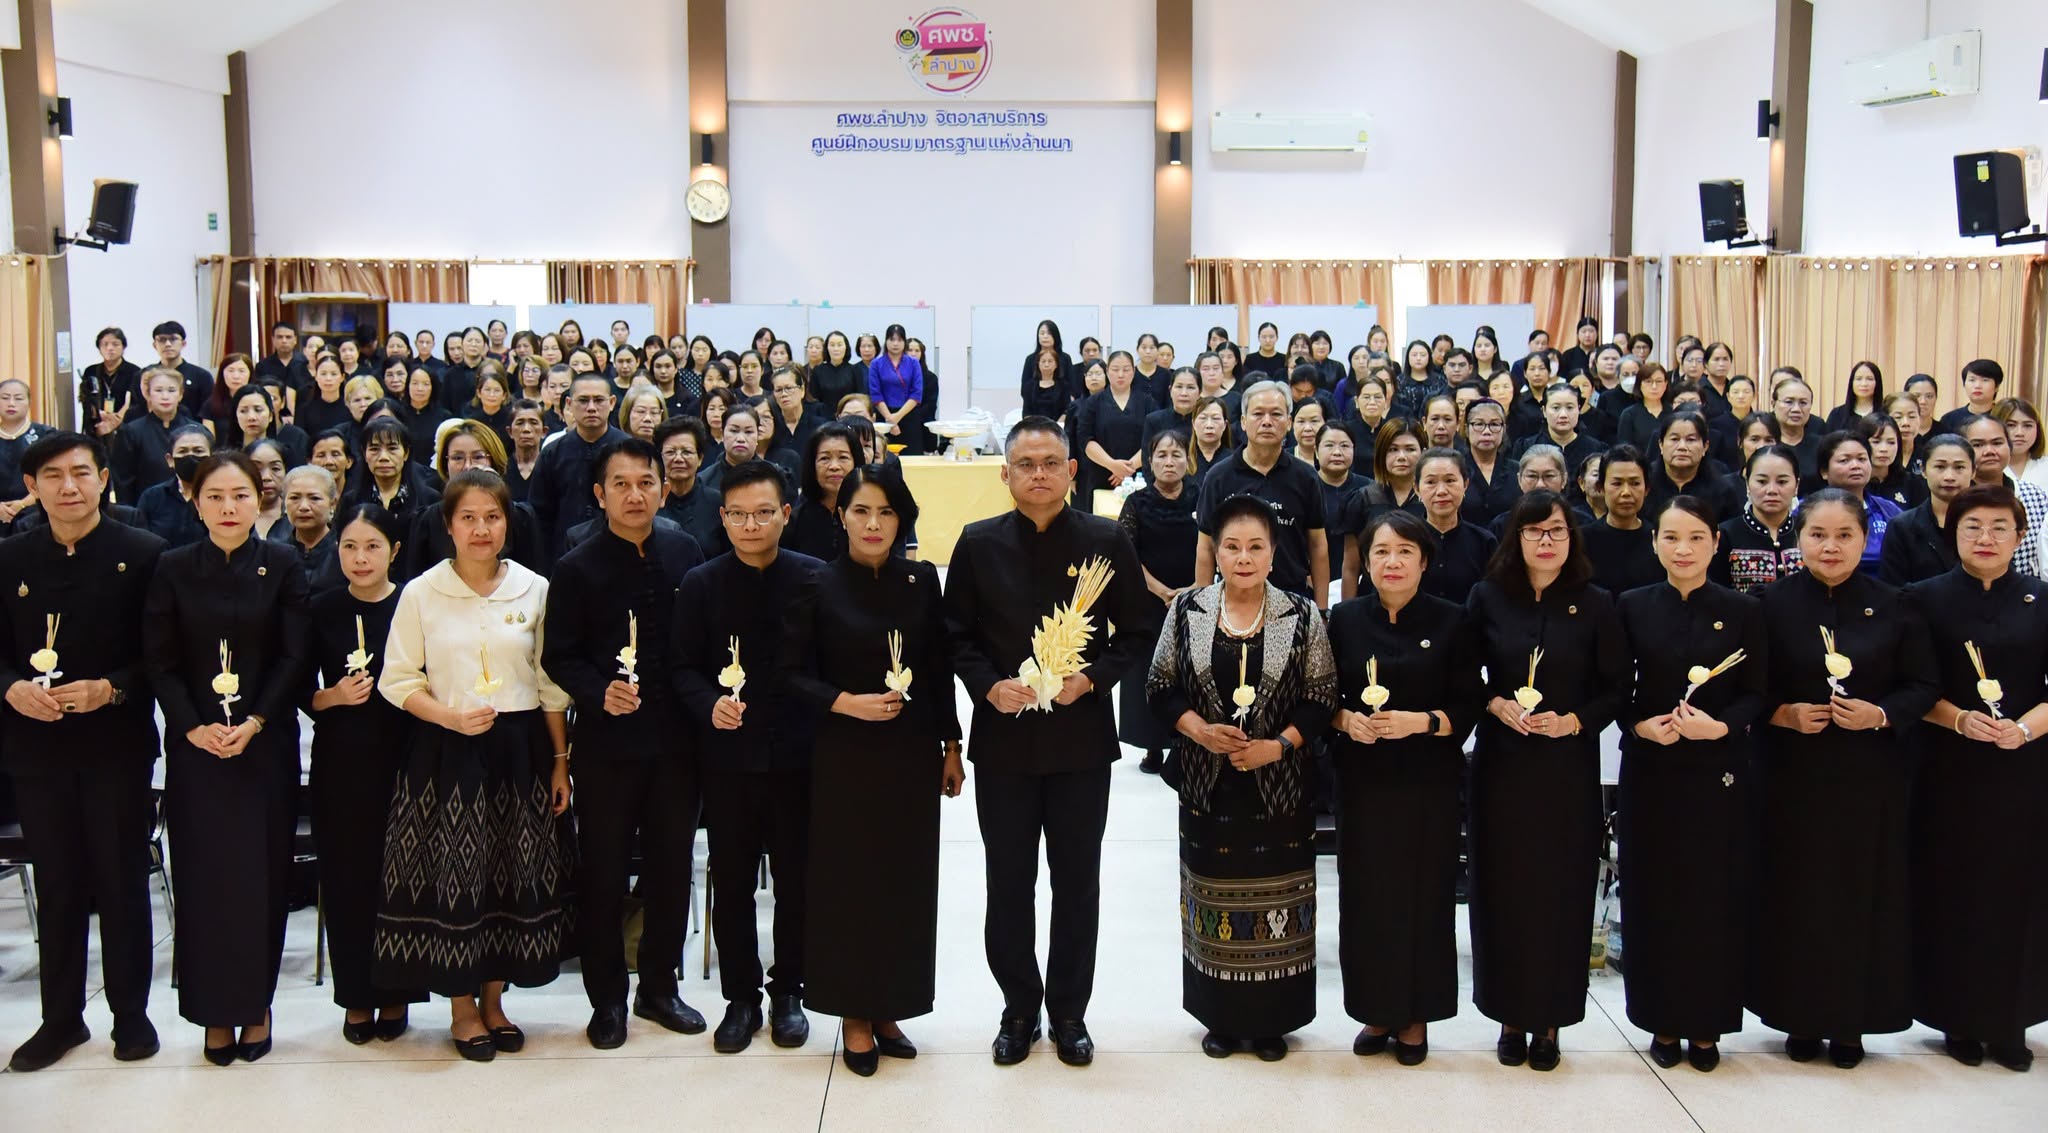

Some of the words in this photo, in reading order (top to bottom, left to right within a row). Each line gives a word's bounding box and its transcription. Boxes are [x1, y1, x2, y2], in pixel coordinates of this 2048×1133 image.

[928, 27, 979, 44] ศพช.
[929, 57, 976, 72] ลำปาง
[836, 109, 928, 127] ศพช.ลำปาง
[935, 109, 1048, 127] จิตอาสาบริการ
